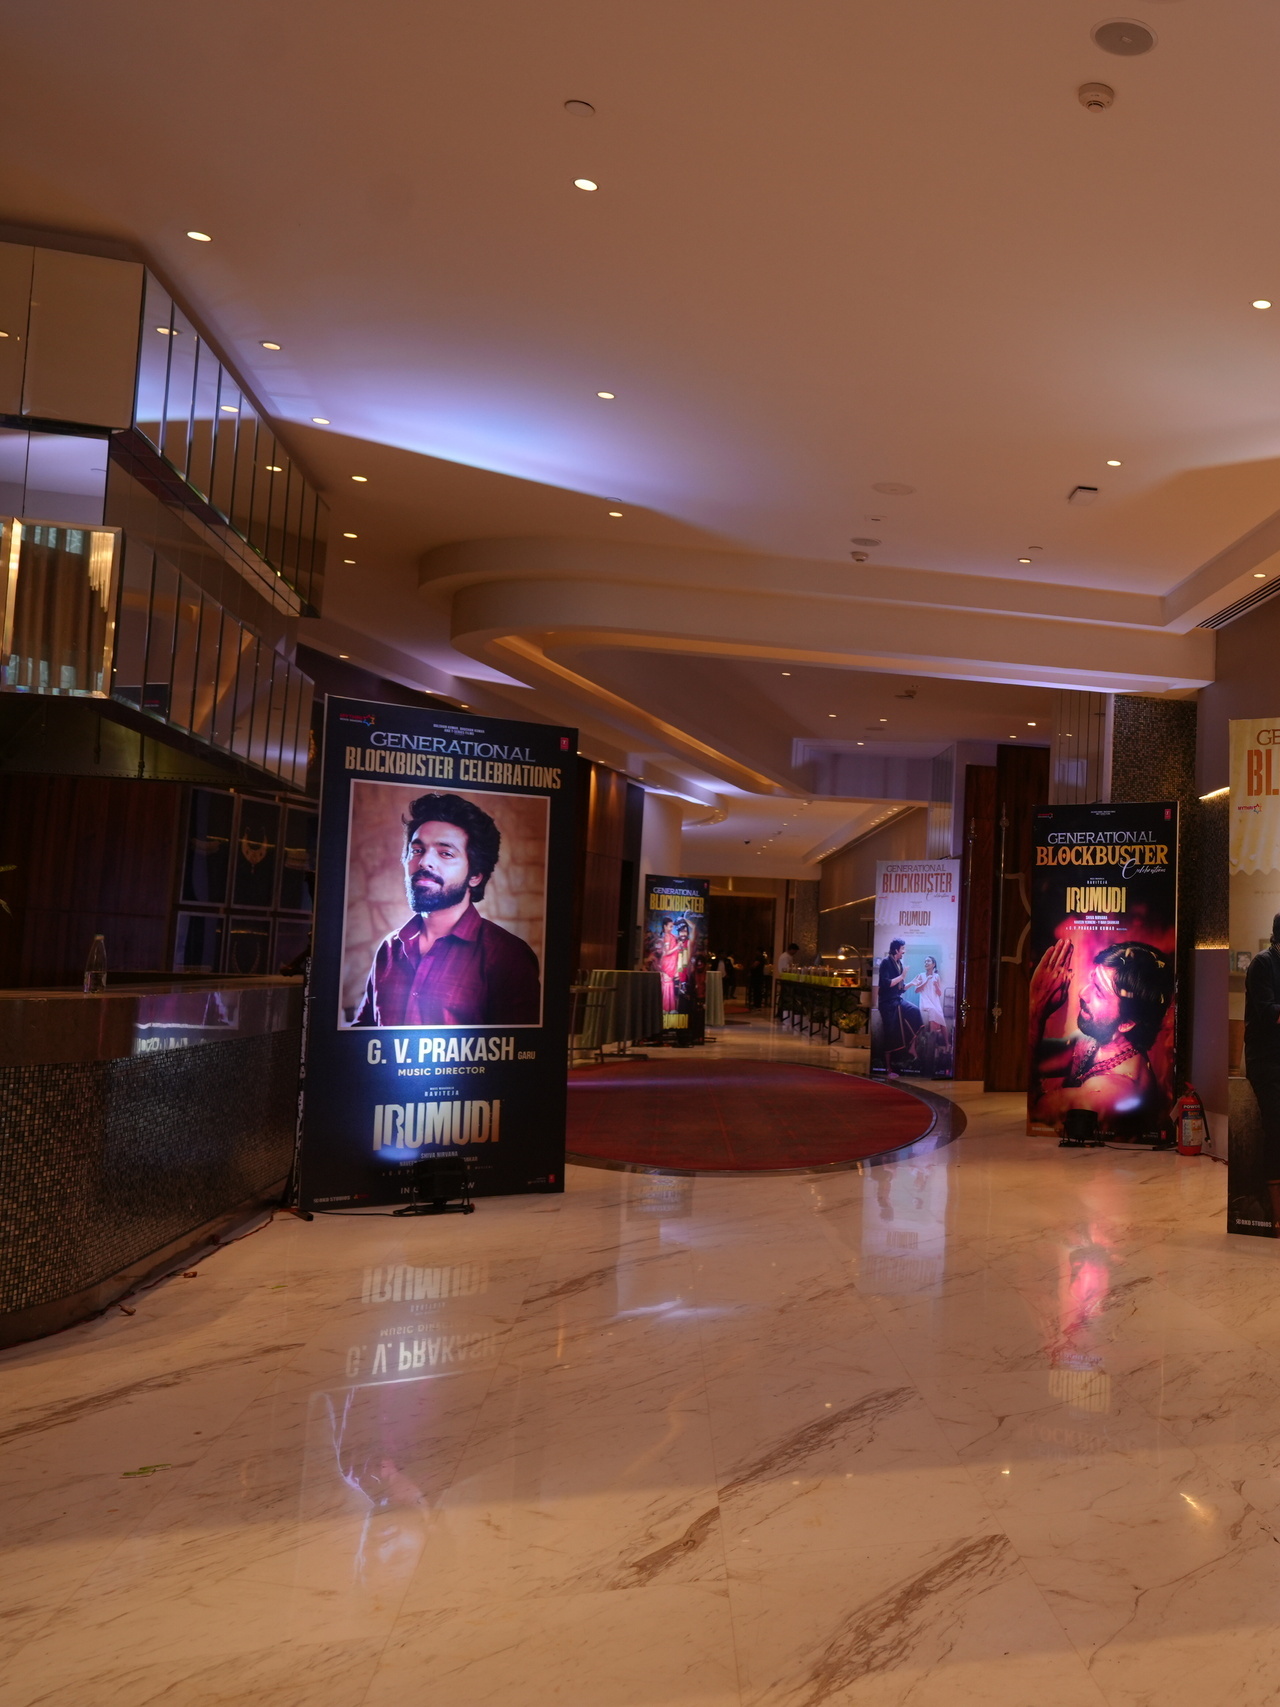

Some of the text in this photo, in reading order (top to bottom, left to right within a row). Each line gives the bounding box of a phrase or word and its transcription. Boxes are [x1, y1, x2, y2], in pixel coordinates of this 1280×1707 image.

[370, 731, 536, 762] GENERATIONAL
[345, 746, 562, 789] BLOCKBUSTER CELEBRATIONS
[1047, 831, 1157, 844] GENERATIONAL
[1036, 844, 1169, 866] BLOCKBUSTER
[886, 864, 947, 873] GENERATIONAL
[652, 886, 700, 897] GENERATIONAL
[882, 872, 953, 893] BLOCKBUSTER
[650, 893, 705, 913] BLOCKBUSTER
[1066, 886, 1127, 913] IRUMUDI
[367, 1036, 536, 1065] G. V. PRAKASH GARU
[397, 1066, 486, 1077] MUSIC DIRECTOR
[372, 1099, 501, 1151] IRUMUDI
